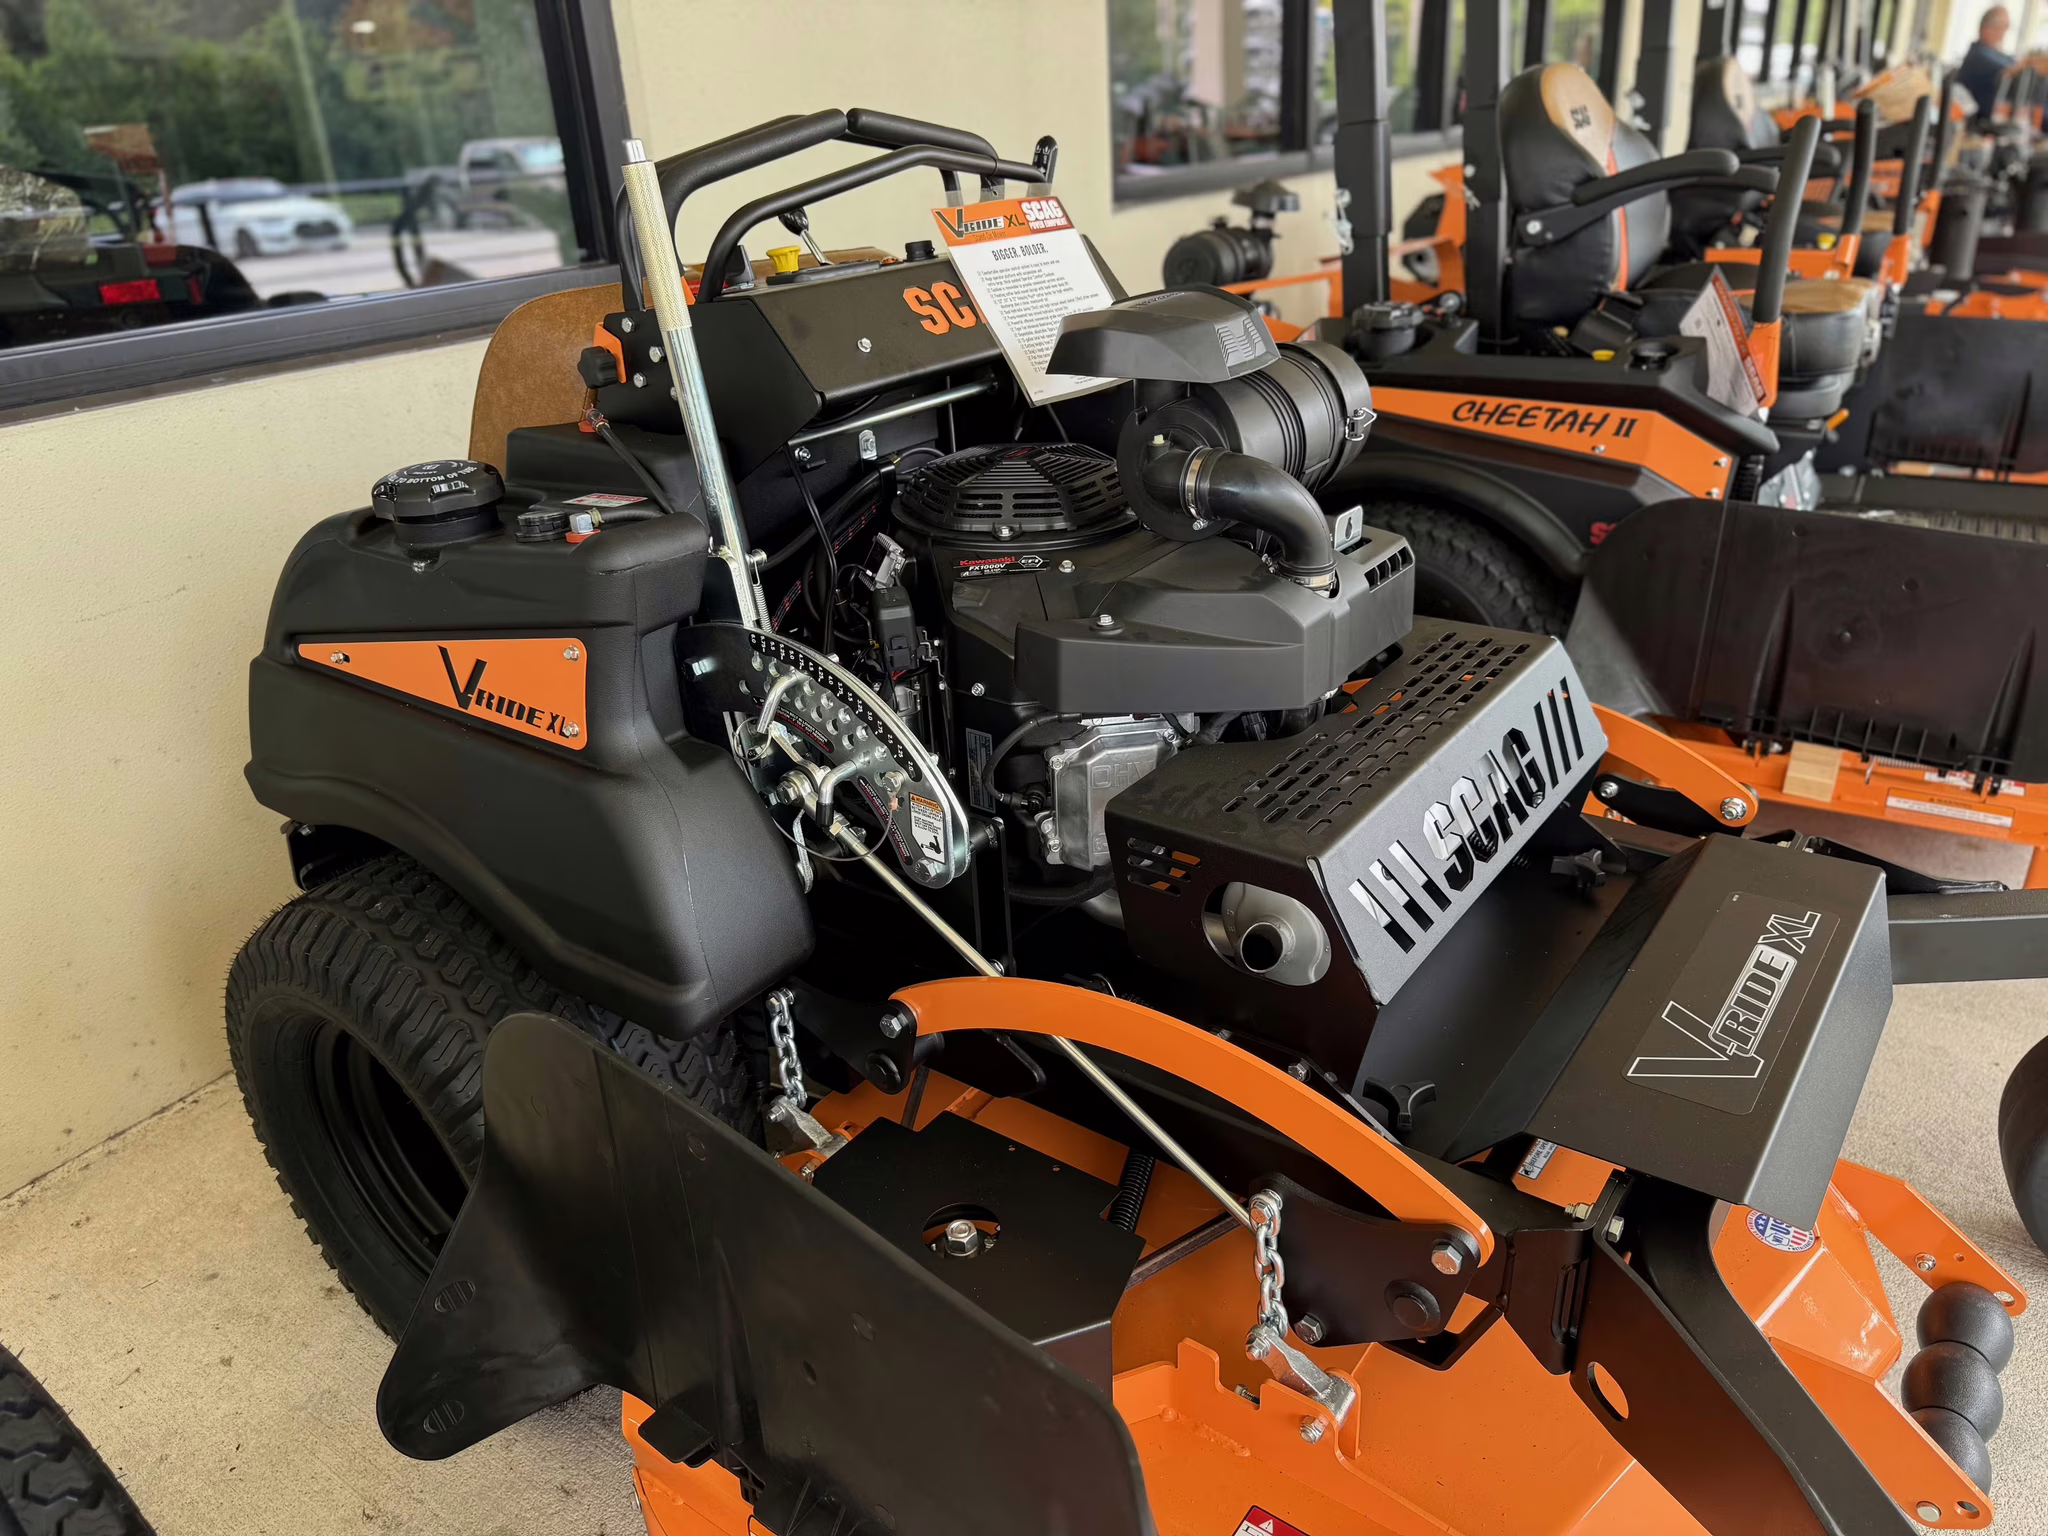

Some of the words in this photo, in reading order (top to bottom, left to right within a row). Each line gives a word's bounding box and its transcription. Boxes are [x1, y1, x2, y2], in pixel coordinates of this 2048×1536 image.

[1003, 214, 1026, 228] XL
[1021, 199, 1064, 222] SCAG
[992, 247, 1021, 261] BIGGER.
[1019, 243, 1049, 257] BOLDER.
[903, 281, 977, 335] SC
[1452, 400, 1610, 437] CHEETAH
[1612, 417, 1638, 438] II
[406, 475, 446, 484] BOTTOM
[960, 556, 1017, 567] Kawasaki
[1423, 728, 1546, 892] SCAG
[1757, 911, 1822, 954] XL
